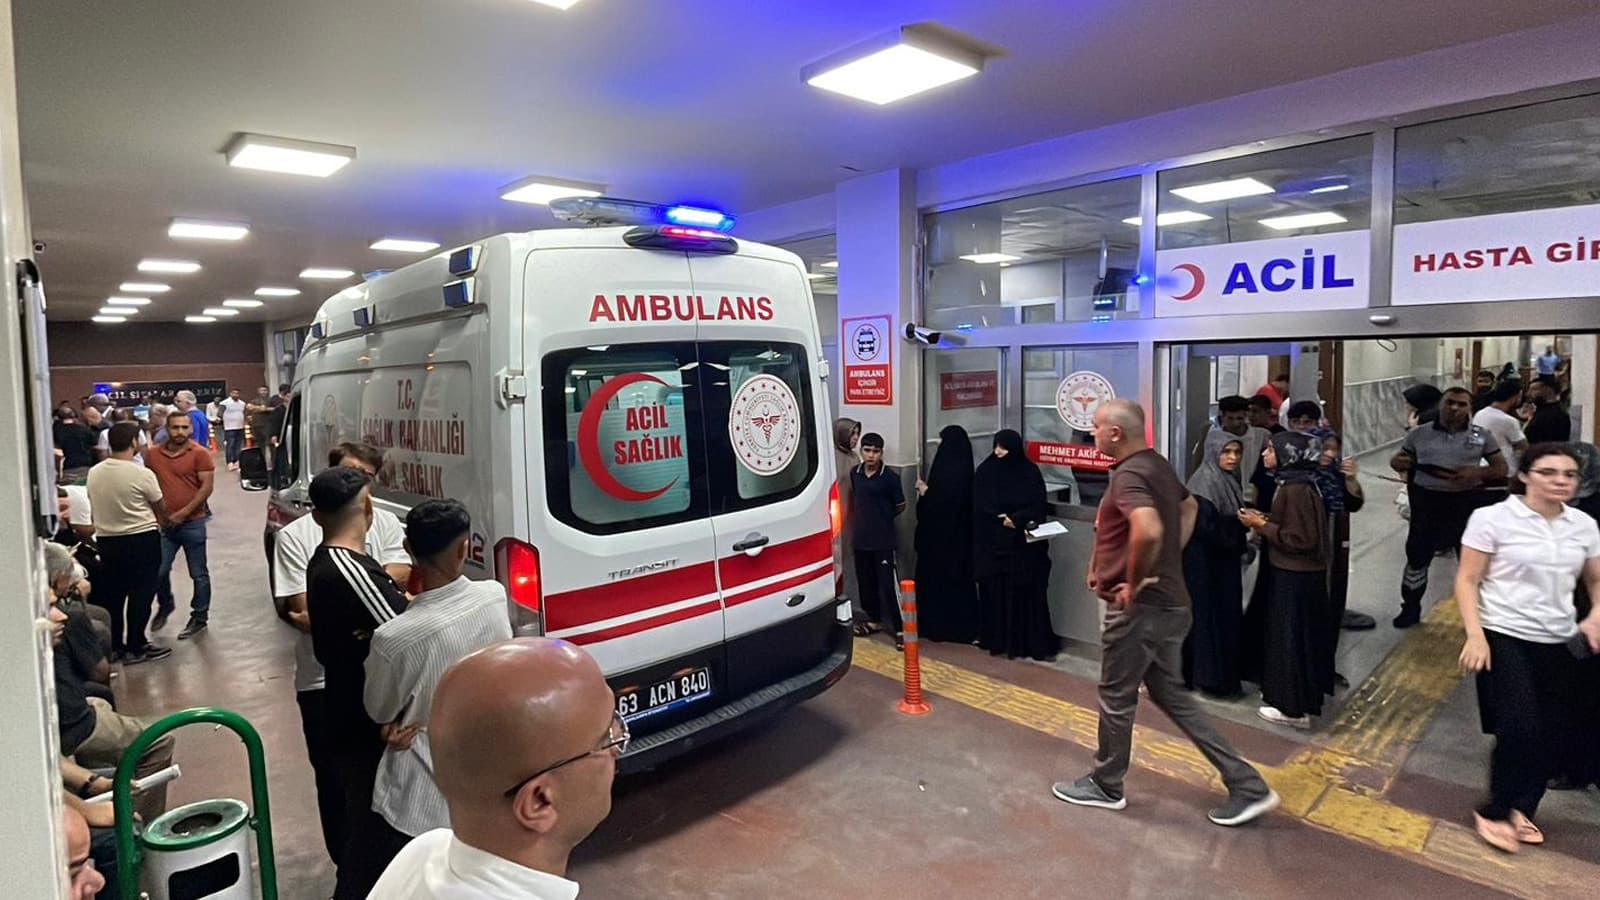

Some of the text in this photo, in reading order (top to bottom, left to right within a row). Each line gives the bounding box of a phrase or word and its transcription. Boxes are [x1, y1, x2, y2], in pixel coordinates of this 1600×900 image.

[1222, 248, 1355, 296] ACİL
[1413, 246, 1533, 274] HASTA
[589, 294, 774, 322] AMBULANS
[397, 379, 415, 410] T.C.
[626, 402, 669, 431] ACİL
[400, 412, 465, 456] BAKANLIĞI
[614, 434, 684, 466] SAĞLIK
[1039, 445, 1076, 457] MEHMET
[1078, 448, 1099, 459] AKİF
[402, 456, 444, 498] SAĞLIK
[608, 558, 679, 580] TRANSIT
[618, 693, 638, 716] 63
[649, 680, 677, 707] ACN
[681, 672, 707, 697] 840
